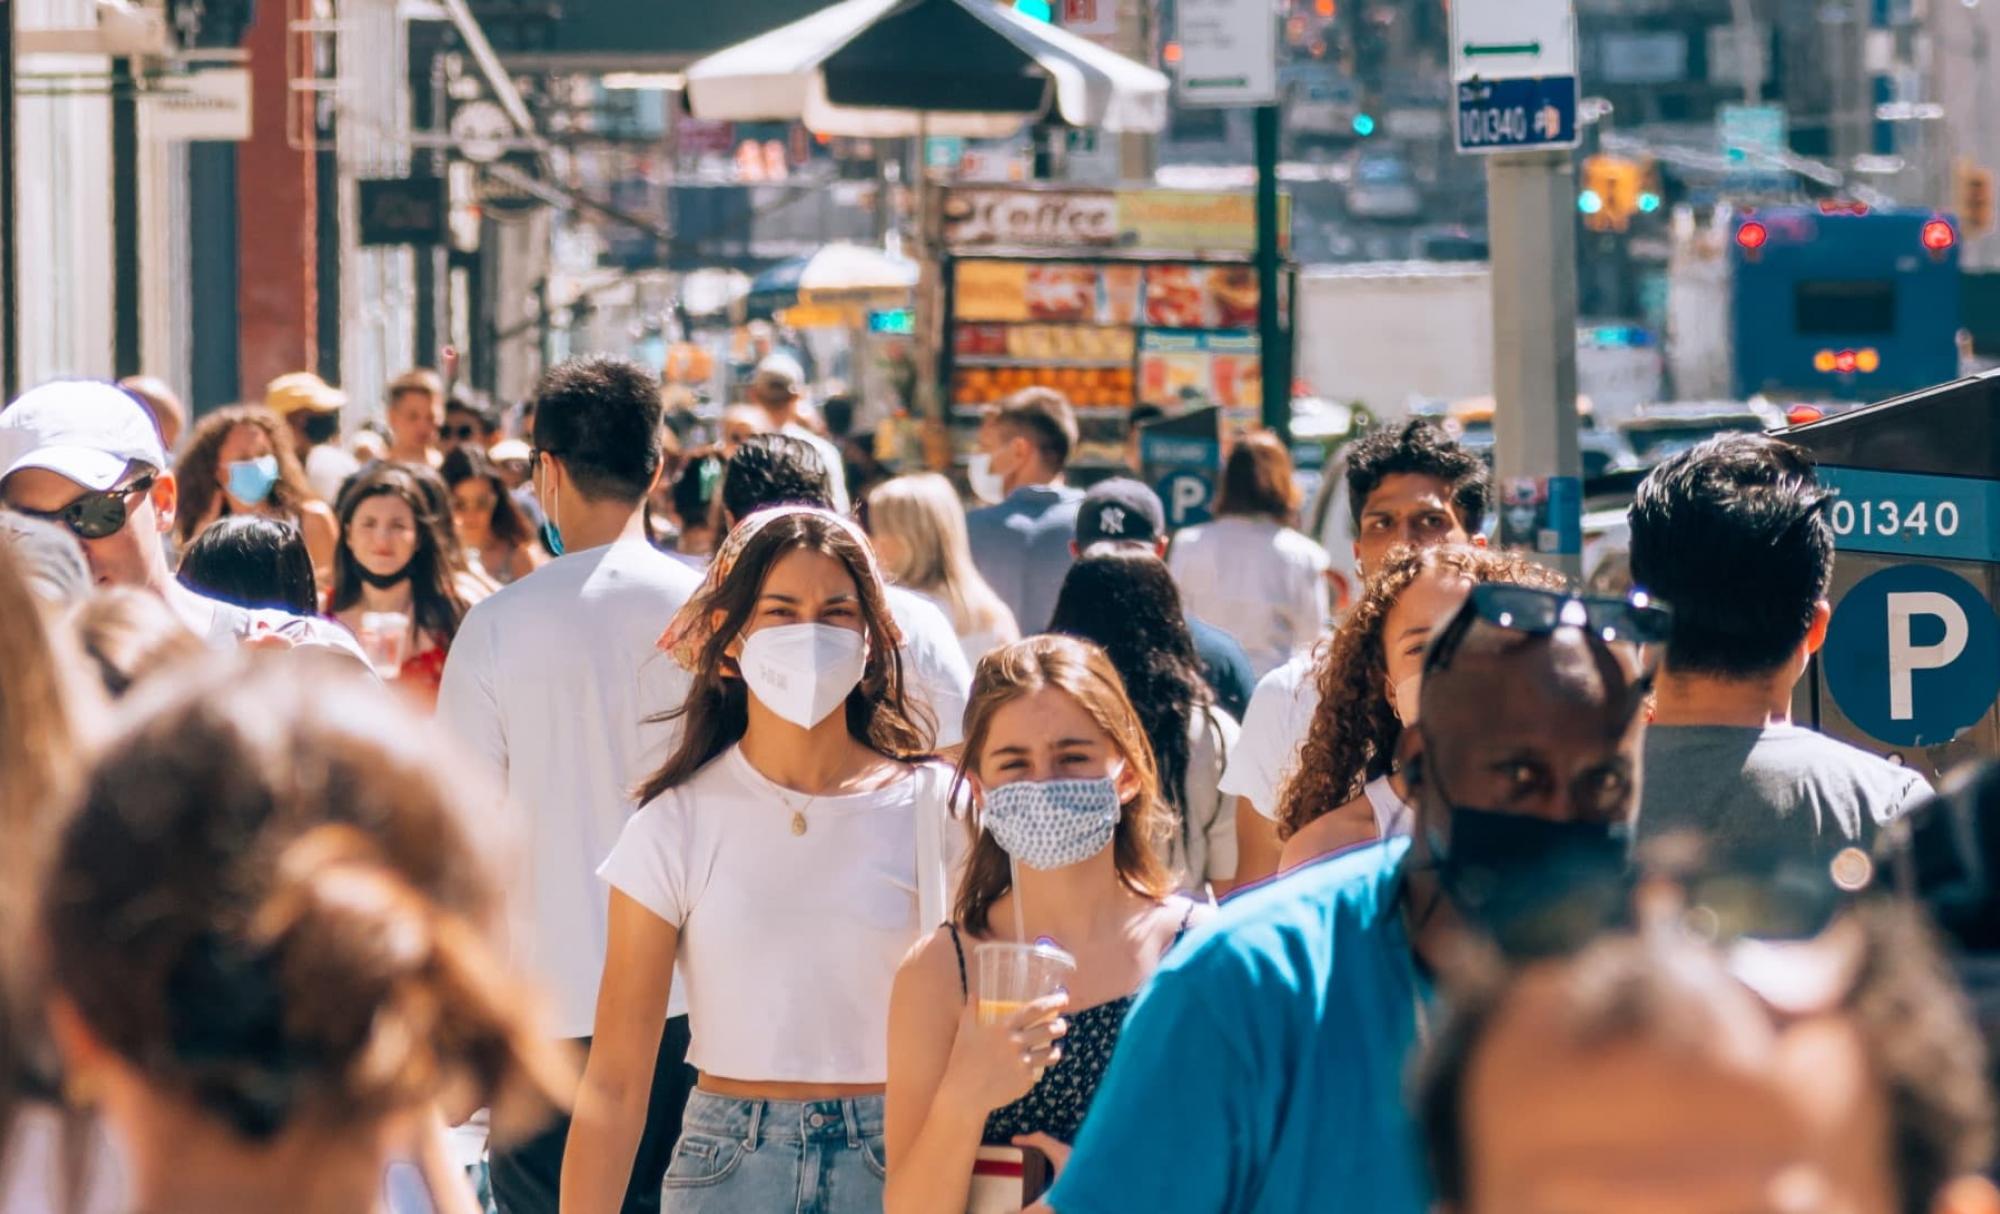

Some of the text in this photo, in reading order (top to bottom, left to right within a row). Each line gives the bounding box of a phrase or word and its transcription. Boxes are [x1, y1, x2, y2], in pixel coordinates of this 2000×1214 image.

[1462, 106, 1527, 143] 101340
[970, 194, 1114, 238] Coffee
[1172, 475, 1206, 523] P
[1887, 591, 1969, 720] P
